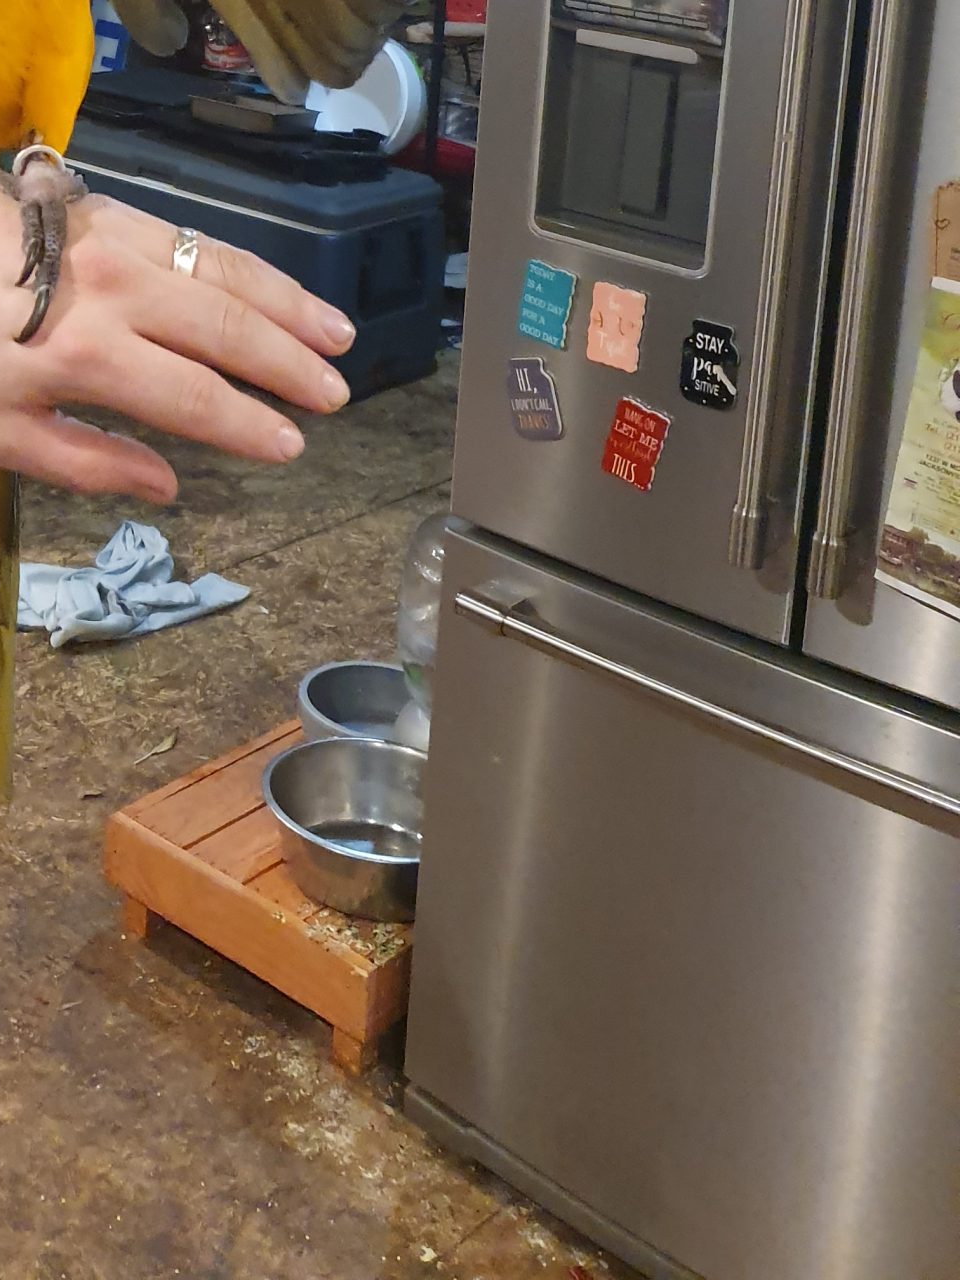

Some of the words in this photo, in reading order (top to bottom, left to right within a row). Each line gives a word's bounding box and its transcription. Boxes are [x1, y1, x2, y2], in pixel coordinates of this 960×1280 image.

[696, 332, 725, 354] STAY
[694, 380, 719, 396] SITIVE
[614, 419, 638, 439] LET
[639, 433, 659, 451] ME
